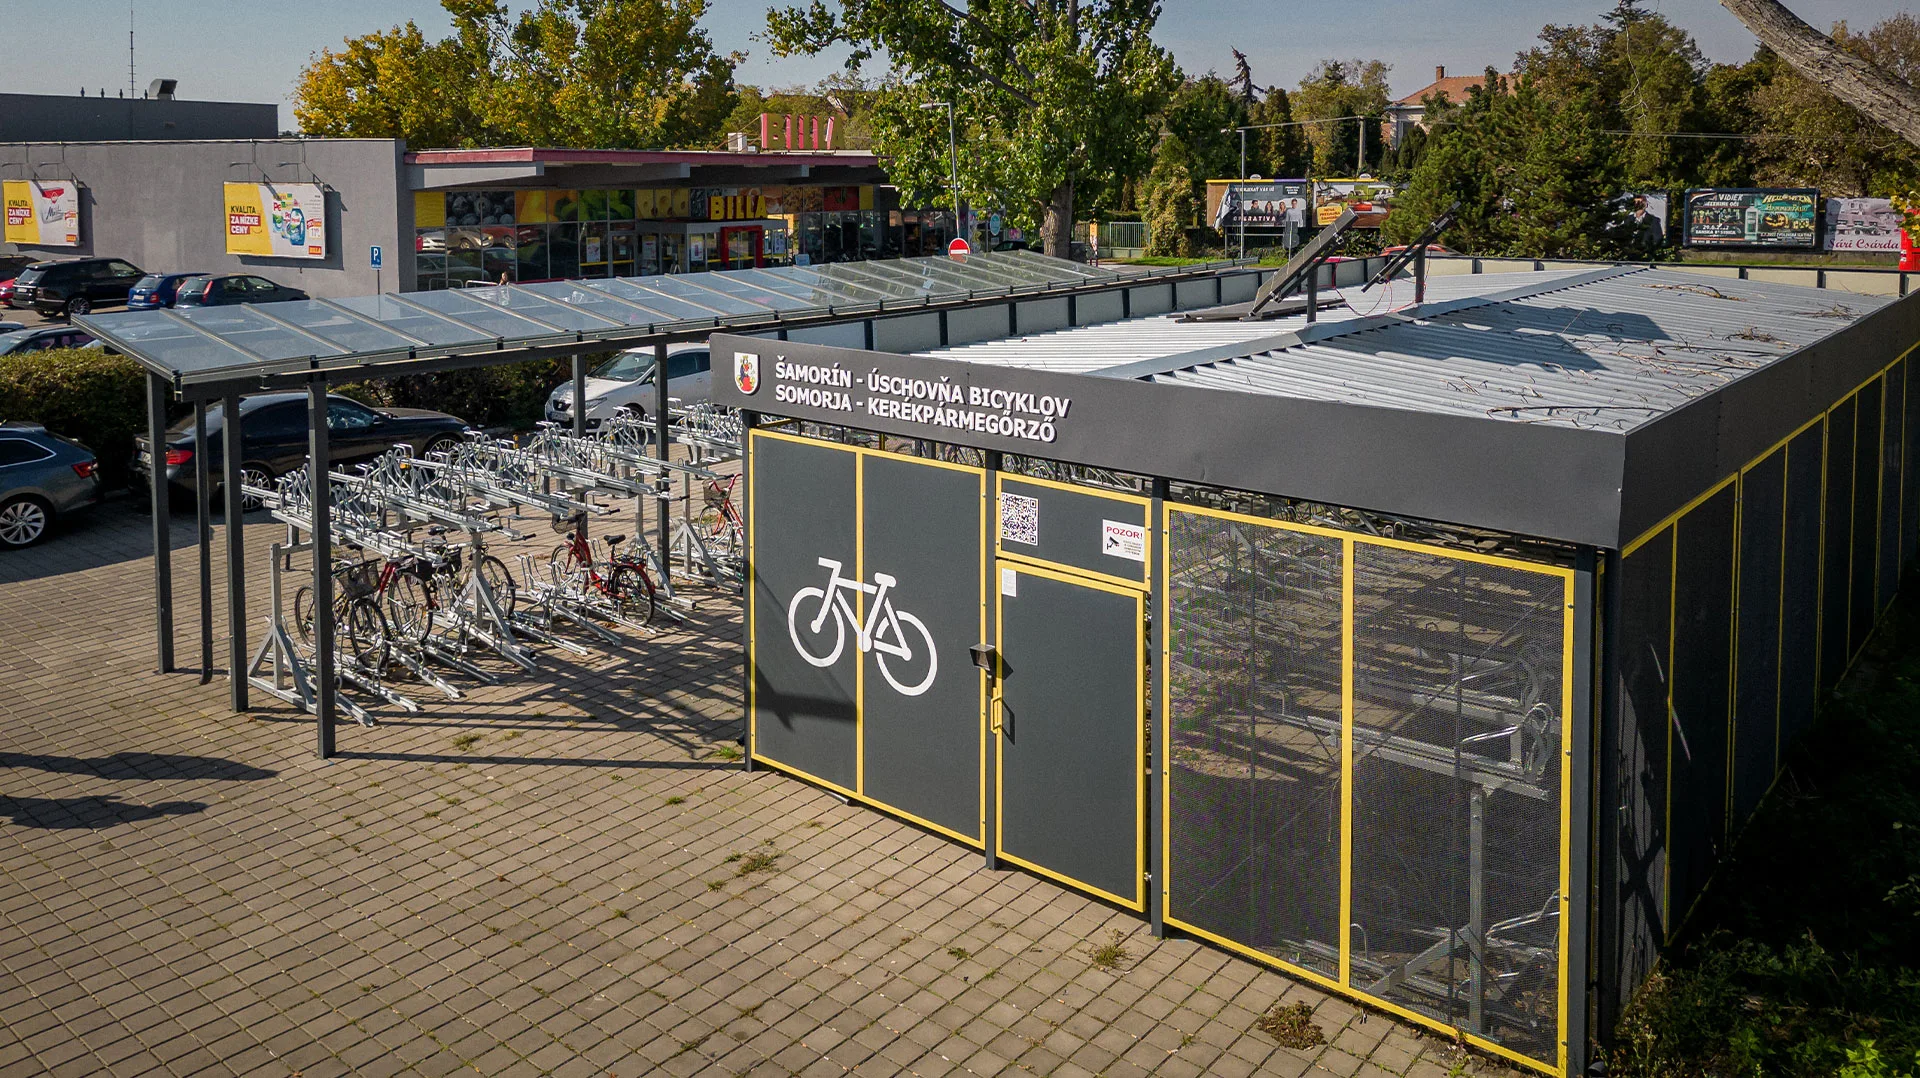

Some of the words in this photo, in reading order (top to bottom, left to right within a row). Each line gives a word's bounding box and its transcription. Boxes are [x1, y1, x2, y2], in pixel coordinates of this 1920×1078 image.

[761, 113, 845, 149] BILLA
[709, 195, 768, 220] BILLA
[231, 215, 239, 224] ZA
[240, 215, 259, 225] NÍZKE
[1828, 239, 1852, 248] Sári
[1856, 239, 1899, 249] Csárda
[374, 248, 378, 260] P
[776, 355, 852, 388] ŠAMORÍN
[868, 367, 965, 404] ÚSCHOVŇA
[969, 386, 1071, 417] BICYKLOV
[776, 384, 853, 412] SOMORJA
[868, 397, 1056, 442] KERÉKPÁRMEGŐRZŐ
[1106, 526, 1143, 539] POZOR!
